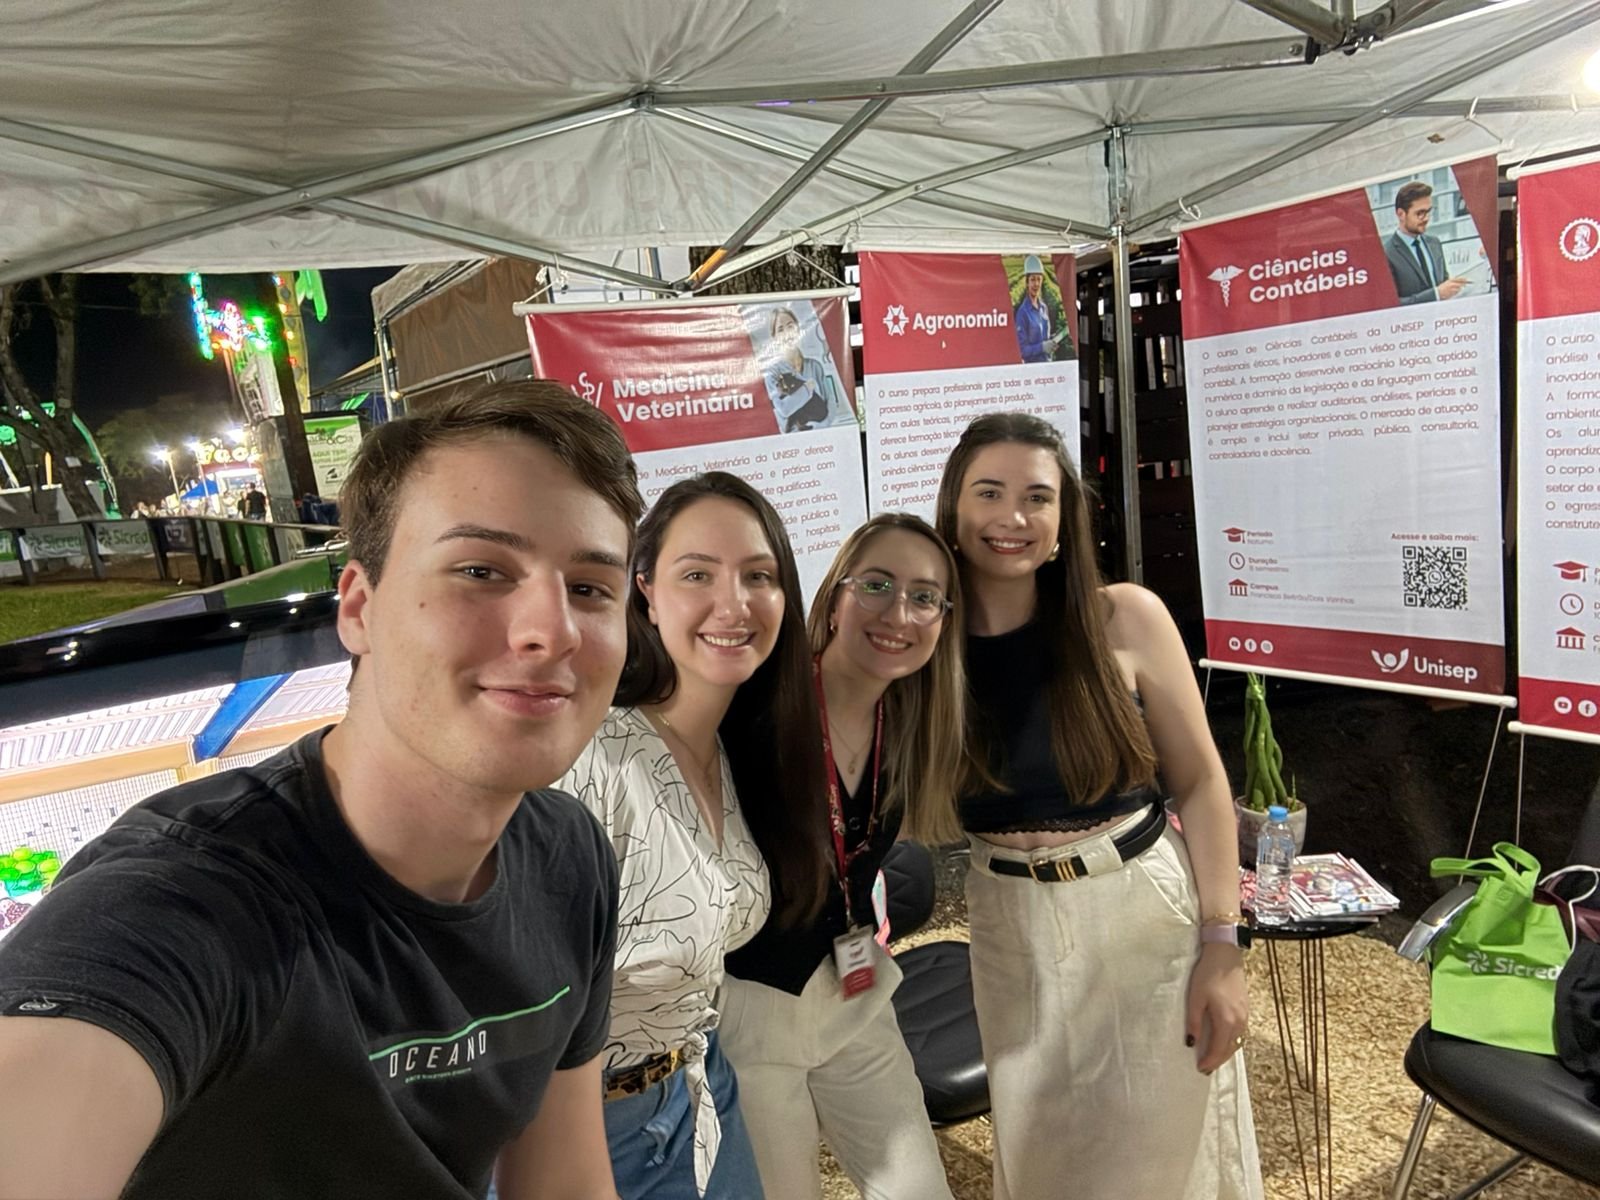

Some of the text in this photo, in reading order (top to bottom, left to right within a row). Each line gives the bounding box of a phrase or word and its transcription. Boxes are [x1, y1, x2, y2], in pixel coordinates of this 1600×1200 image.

[1248, 249, 1348, 281] Ciências
[1249, 267, 1369, 303] Contábeis
[912, 309, 1008, 335] Agronomia
[1202, 315, 1478, 360] O curso de Ciências Contábeis da UNISEP prepara
[1546, 334, 1595, 346] O curso
[1203, 332, 1478, 376] profissionais éticos, inovadores e com visão crítica da área
[1546, 352, 1589, 365] análise
[1204, 378, 1237, 390] contábil.
[1240, 376, 1246, 385] A
[1249, 371, 1292, 384] formação
[1295, 366, 1345, 378] desenvolve
[1349, 358, 1395, 372] raciocínio
[1437, 350, 1478, 364] aptidão
[613, 371, 726, 400] Medicina
[879, 390, 885, 399] O
[889, 390, 909, 398] curso
[913, 387, 941, 399] prepara
[944, 383, 983, 396] profissionais
[986, 381, 1001, 392] para
[1004, 380, 1022, 388] todas
[1035, 377, 1055, 387] etapas
[1205, 367, 1478, 404] numérica e domínio da legislação e da linguagem contábil.
[880, 405, 912, 417] processo
[913, 401, 942, 413] agrícola,
[944, 400, 953, 408] do
[954, 397, 998, 411] planejamento
[1005, 393, 1035, 404] produção.
[1205, 409, 1213, 418] O
[1215, 407, 1239, 417] aluno
[1240, 405, 1275, 416] aprende
[1287, 399, 1318, 411] realizar
[1321, 395, 1368, 408] auditorias,
[1371, 392, 1413, 403] análises,
[1416, 386, 1456, 401] perícias
[1460, 387, 1467, 395] e
[1471, 386, 1479, 394] a
[1546, 392, 1555, 402] A
[616, 391, 754, 423] Veterinária
[880, 421, 898, 430] Com
[901, 418, 921, 428] aulas
[923, 416, 952, 426] teóricas,
[1207, 403, 1479, 434] planejar estratégias organizacionais. O mercado de atuação
[880, 435, 907, 446] oferece
[909, 432, 942, 442] formação
[1221, 435, 1248, 448] amplo
[1268, 433, 1290, 443] inclui
[1299, 431, 1320, 440] setor
[1421, 420, 1480, 433] consultoria,
[1546, 428, 1562, 439] Os
[655, 464, 698, 478] Medicina
[704, 456, 751, 472] Veterinária
[755, 454, 768, 464] da
[772, 449, 800, 461] UNISEP
[804, 445, 834, 457] oferece
[881, 453, 891, 462] Os
[894, 451, 918, 460] alunos
[1209, 447, 1312, 460] controladoria e docência.
[770, 470, 776, 478] e
[782, 465, 811, 479] prática
[817, 461, 836, 471] com
[882, 468, 907, 478] unindo
[908, 464, 936, 475] ciências
[1546, 465, 1556, 475] O
[1560, 466, 1595, 477] corpo
[882, 484, 889, 493] O
[891, 481, 919, 493] egresso
[1546, 484, 1574, 493] setor
[1578, 483, 1594, 493] de
[796, 498, 810, 507] em
[1546, 501, 1556, 511] O
[801, 510, 830, 523] pública
[806, 524, 841, 537] hospitais
[1429, 533, 1453, 541] saiba
[1249, 557, 1278, 566] Duração
[1250, 583, 1279, 592] Campus
[1413, 655, 1478, 684] Unisep
[1493, 957, 1563, 980] Sicred
[389, 1030, 487, 1078] OCEANO
